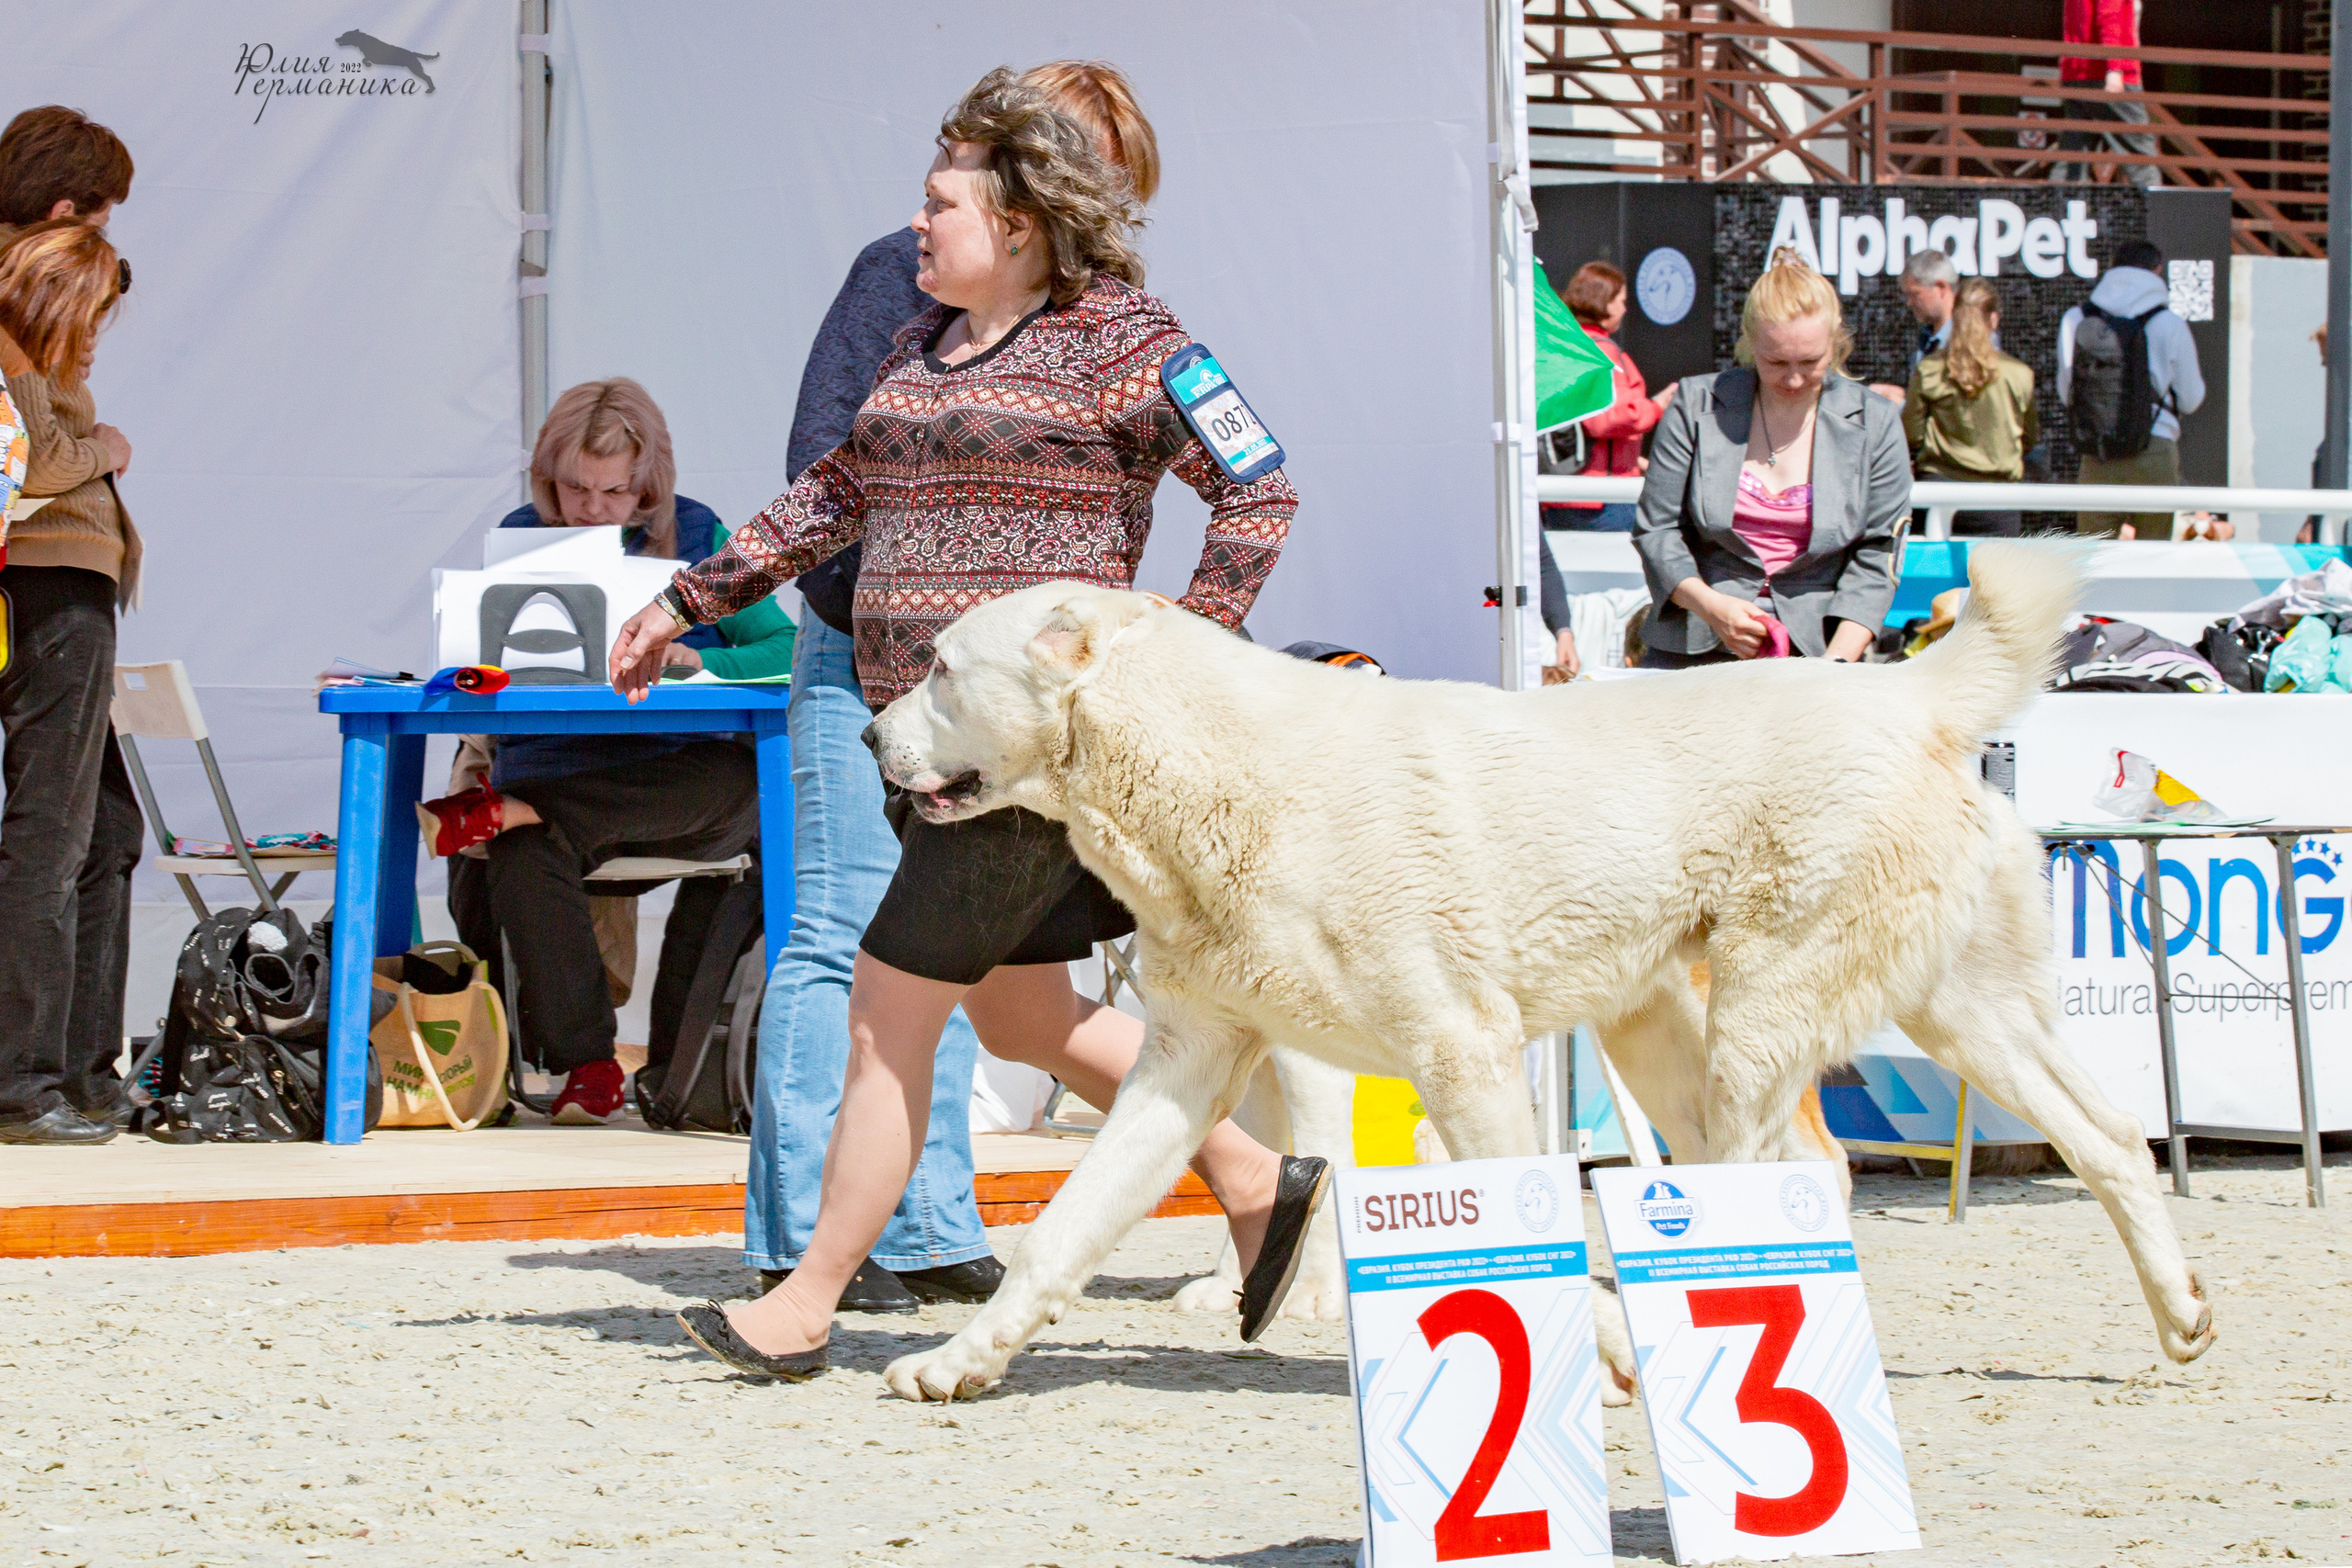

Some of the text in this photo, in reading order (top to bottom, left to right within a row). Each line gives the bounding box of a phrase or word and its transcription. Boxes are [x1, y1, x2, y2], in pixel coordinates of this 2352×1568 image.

[1763, 196, 2098, 296] AlphaPet
[2057, 976, 2160, 1016] atura
[1365, 1189, 1479, 1232] SIRIUS
[1640, 1202, 1693, 1217] Farmina
[1391, 1262, 1414, 1271] КУБОК
[1415, 1258, 1456, 1270] ПРЕЗИДЕНТА
[1525, 1252, 1546, 1261] КУБОК
[1653, 1257, 1678, 1265] КУБОК
[1678, 1255, 1724, 1263] ПРЕЗИДЕНТА
[1798, 1249, 1822, 1258] КУБОК
[1655, 1267, 1698, 1276] ВСЕМИРНАЯ
[1698, 1265, 1735, 1273] ВЫСТАВКА
[1736, 1263, 1758, 1271] СОБАК
[1758, 1259, 1804, 1270] РОССИЙСКИХ
[1804, 1259, 1829, 1269] ПОРОД
[1392, 1272, 1430, 1282] ВСЕМИРНАЯ
[1431, 1269, 1466, 1280] ВЫСТАВКА
[1466, 1268, 1487, 1277] СОБАК
[1488, 1263, 1529, 1275] РОССИЙСКИХ
[1530, 1263, 1552, 1272] ПОРОД
[1685, 1283, 1849, 1537] 3
[1417, 1289, 1551, 1562] 2
